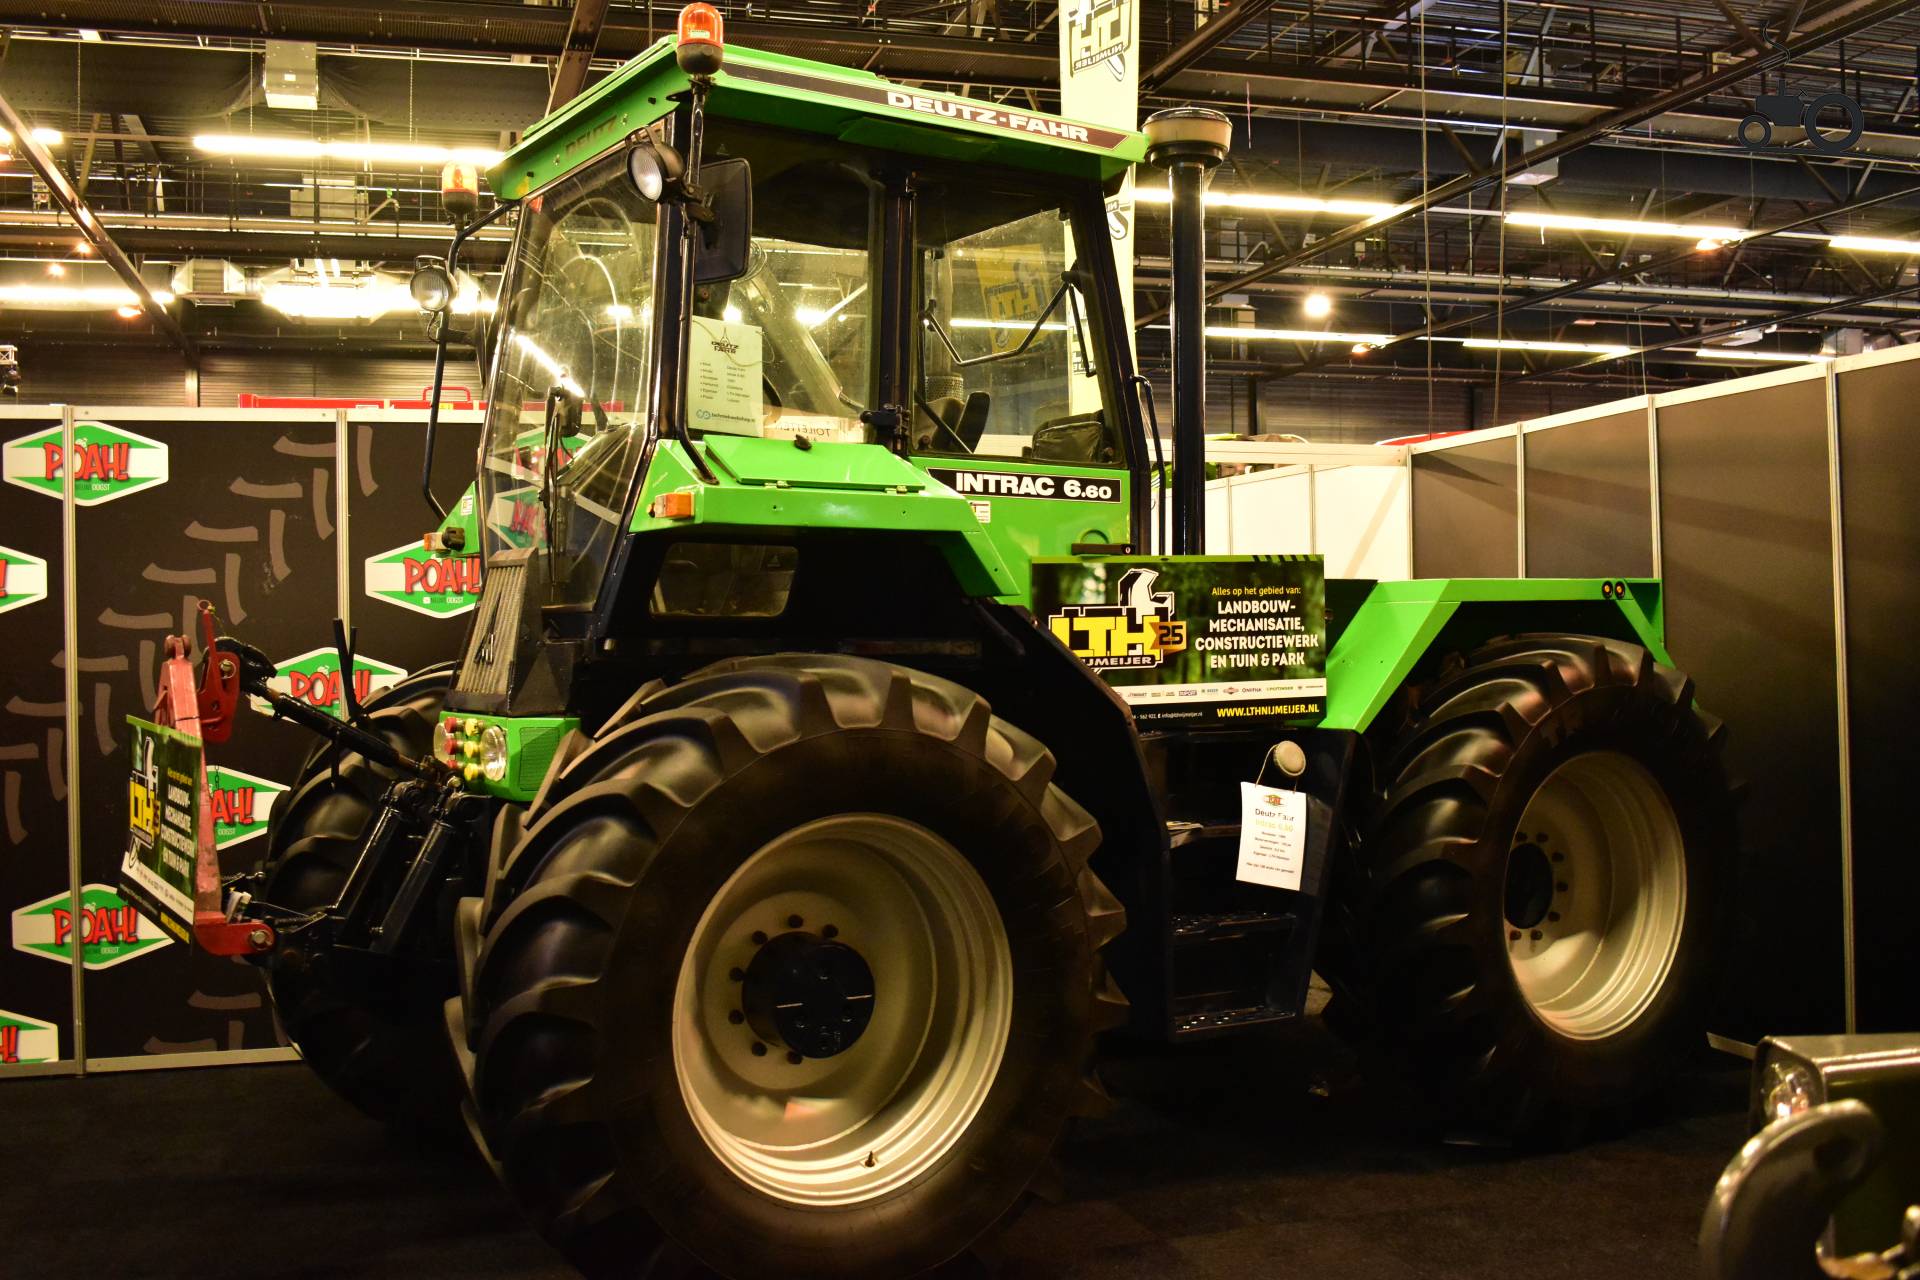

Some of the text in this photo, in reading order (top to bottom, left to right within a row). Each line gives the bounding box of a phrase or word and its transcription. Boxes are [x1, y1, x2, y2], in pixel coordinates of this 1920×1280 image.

[886, 90, 1089, 142] DEUTZ-FAHR
[956, 472, 1113, 499] INTRAC 6.60
[402, 556, 481, 595] POAH!
[1212, 586, 1302, 598] Alles op het gebied van:
[1217, 599, 1296, 615] LANDBOUW-
[1209, 616, 1305, 633] MECHANISATIE,
[1158, 624, 1184, 646] 25
[1194, 633, 1319, 651] CONSTRUCTIEWERK
[1210, 651, 1306, 669] EN TUIN & PARK
[1216, 703, 1320, 718] WWW.LTHNIJMEIJER.NL
[211, 786, 255, 825] AH!
[1255, 808, 1276, 818] Deutz
